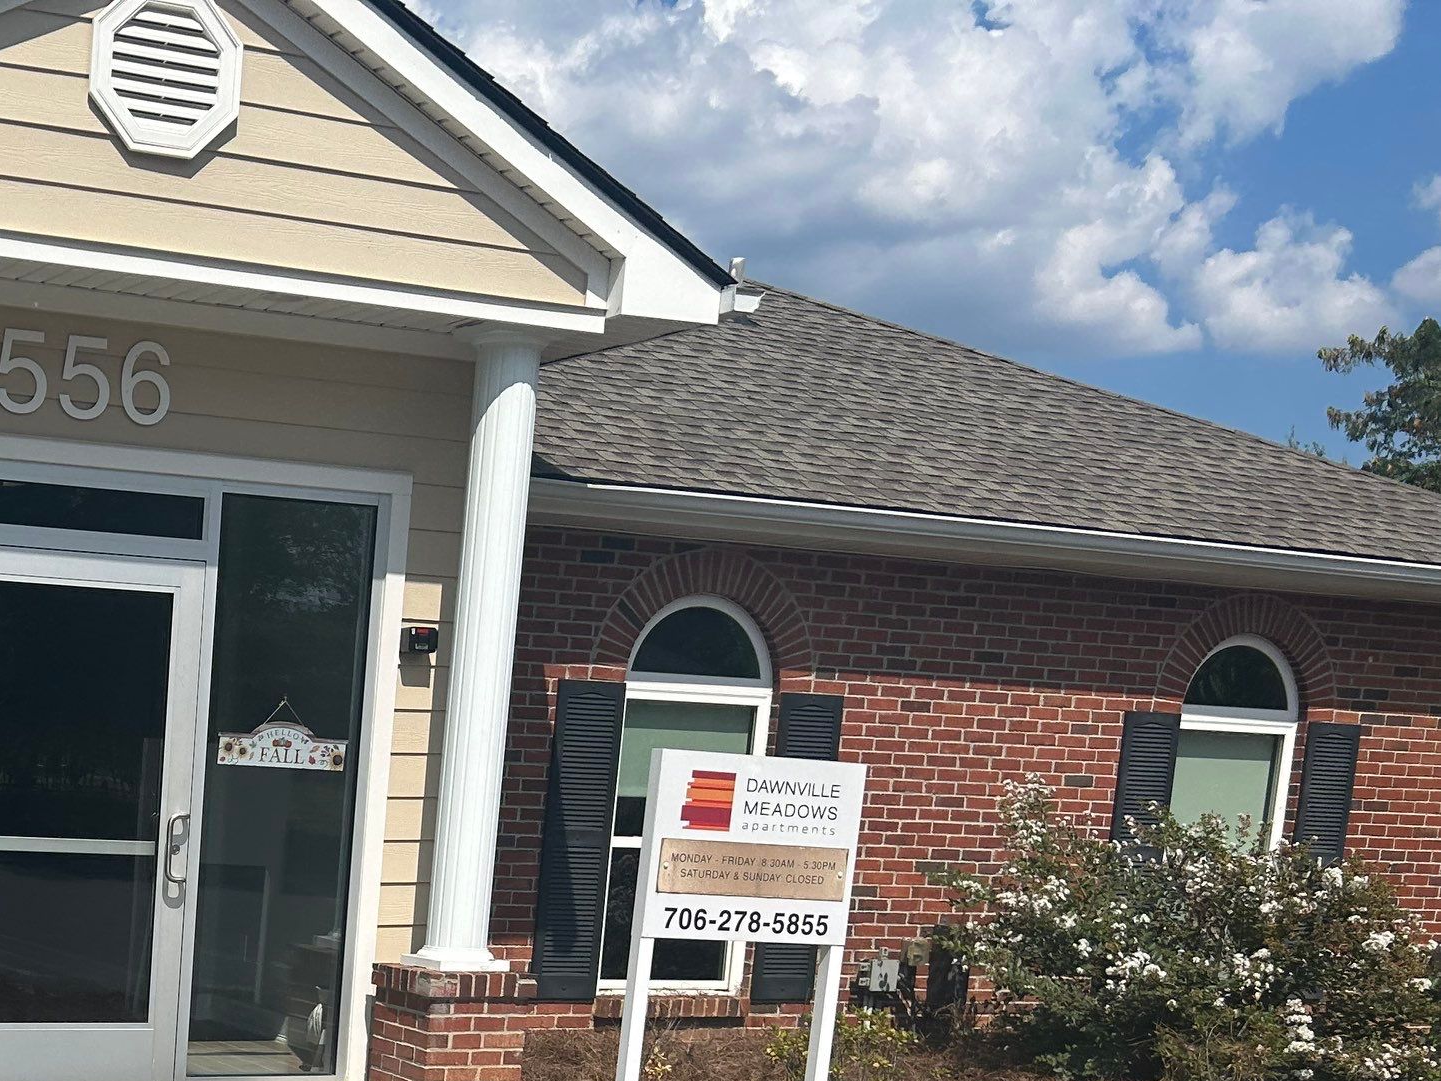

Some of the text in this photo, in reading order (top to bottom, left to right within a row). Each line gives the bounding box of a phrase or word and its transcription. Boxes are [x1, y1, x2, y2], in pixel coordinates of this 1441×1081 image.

[266, 729, 299, 740] HELLO
[258, 747, 304, 764] FALL
[746, 778, 841, 799] DAWNVILLE
[743, 801, 838, 821] MEADOWS
[742, 822, 836, 836] apartments
[671, 853, 712, 863] MONDAY
[680, 868, 730, 879] SATURDAY
[733, 872, 739, 881] &
[785, 874, 825, 885] CLOSED
[664, 907, 829, 936] 706-278-5855
